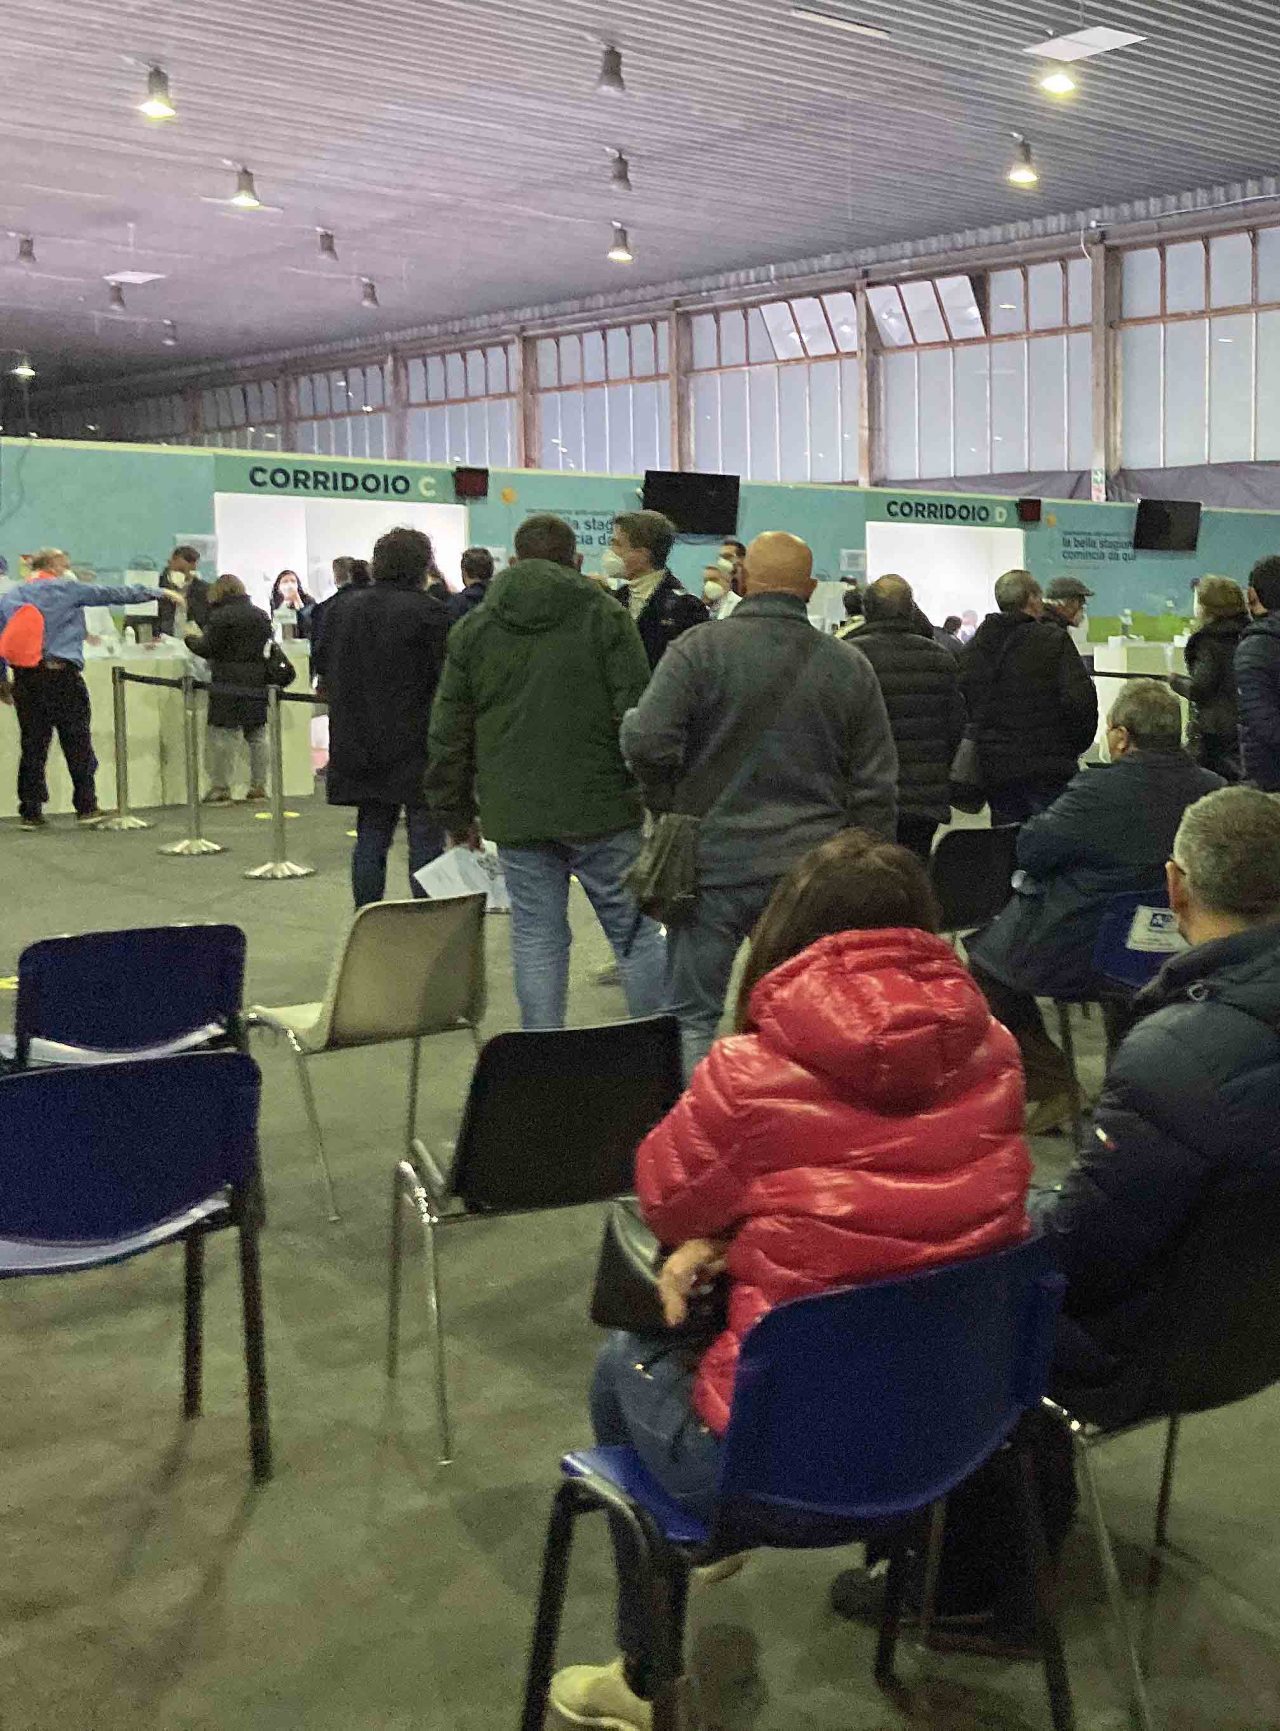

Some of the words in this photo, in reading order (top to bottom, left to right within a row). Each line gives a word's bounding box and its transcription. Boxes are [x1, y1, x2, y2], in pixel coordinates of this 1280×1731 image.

[250, 466, 411, 495] CORRIDOIO
[418, 476, 437, 498] C
[886, 501, 990, 522] CORRIDOIO
[995, 507, 1008, 523] D
